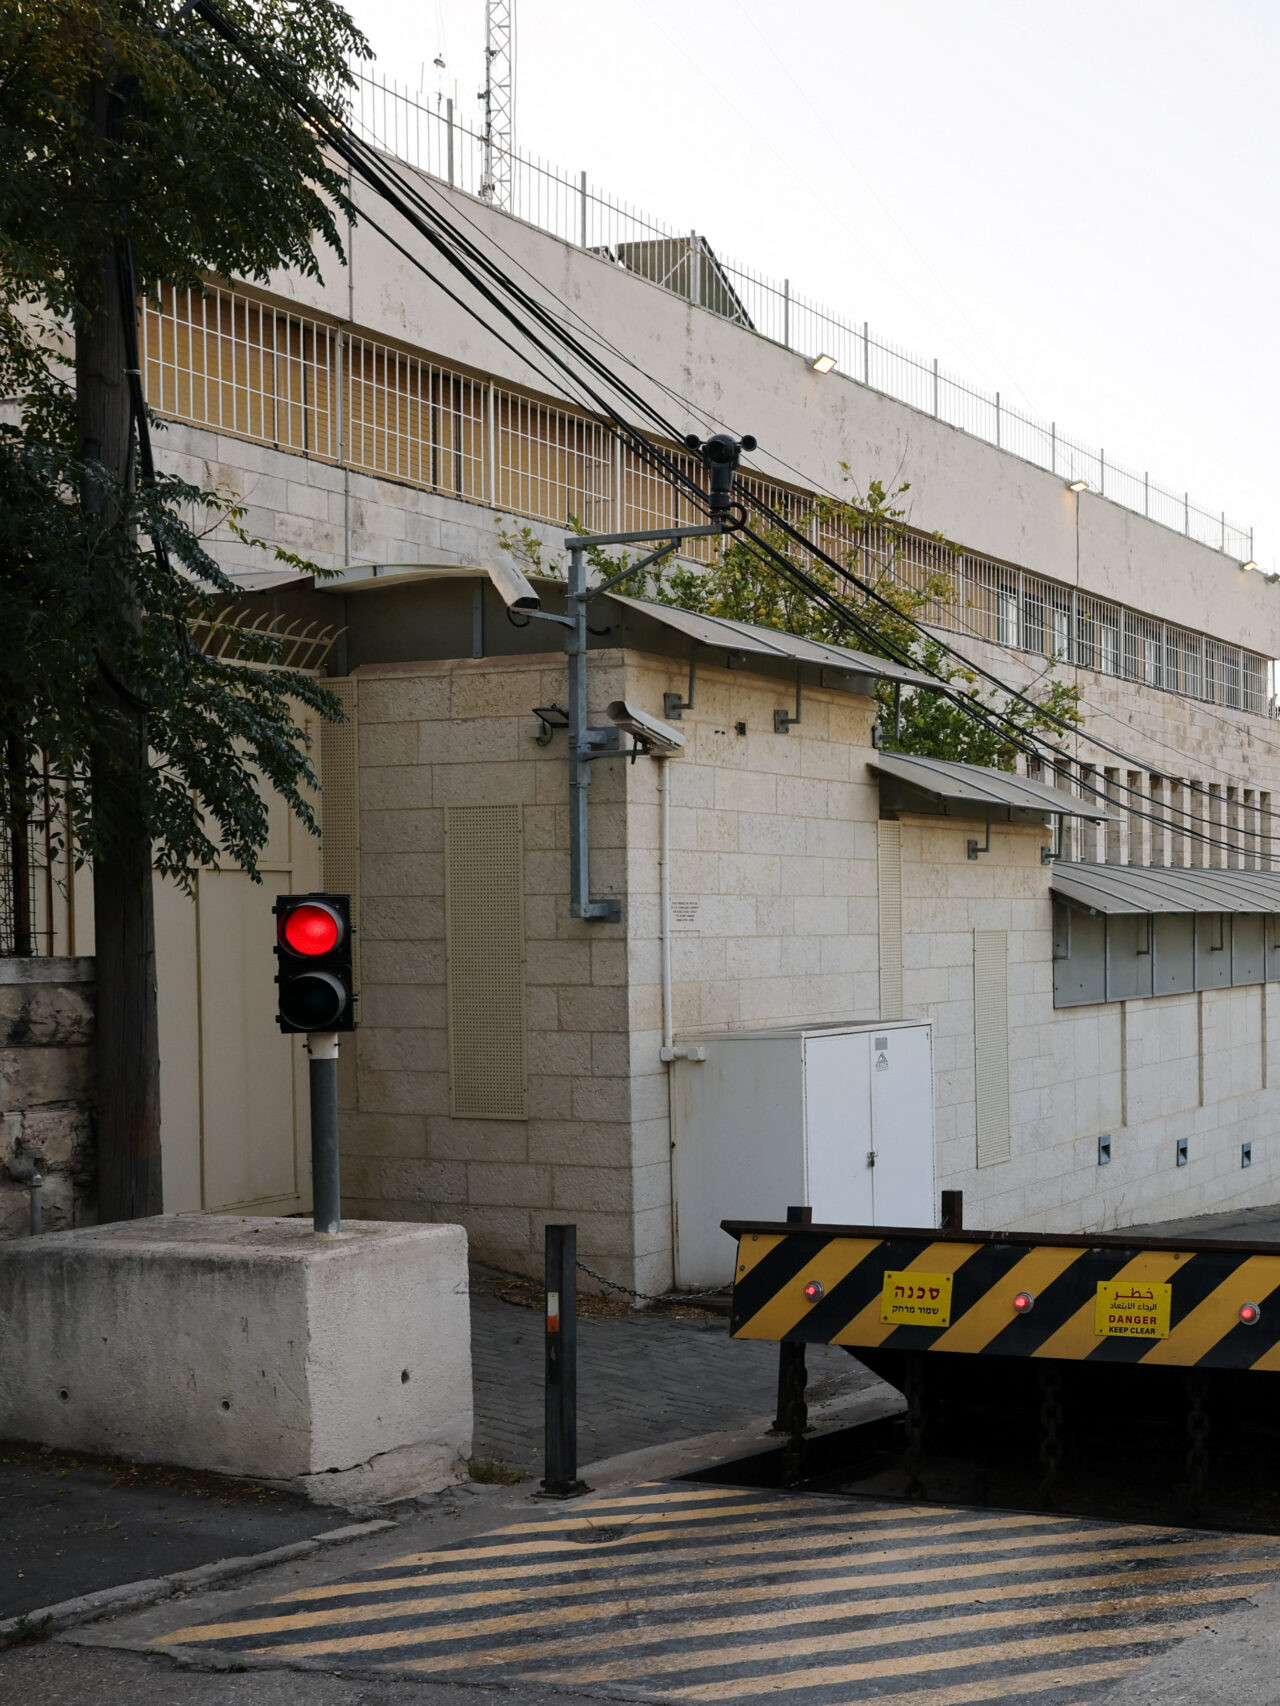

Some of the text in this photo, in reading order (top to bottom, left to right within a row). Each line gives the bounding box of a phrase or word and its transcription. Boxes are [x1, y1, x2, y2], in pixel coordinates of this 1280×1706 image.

[894, 1285, 940, 1300] סכנה
[1113, 1287, 1154, 1301] خطر
[892, 1305, 939, 1315] שמור מרחק
[1137, 1302, 1157, 1312] الرجاء
[1108, 1314, 1157, 1325] DANGER
[1108, 1326, 1156, 1335] KEEP CLEAR
